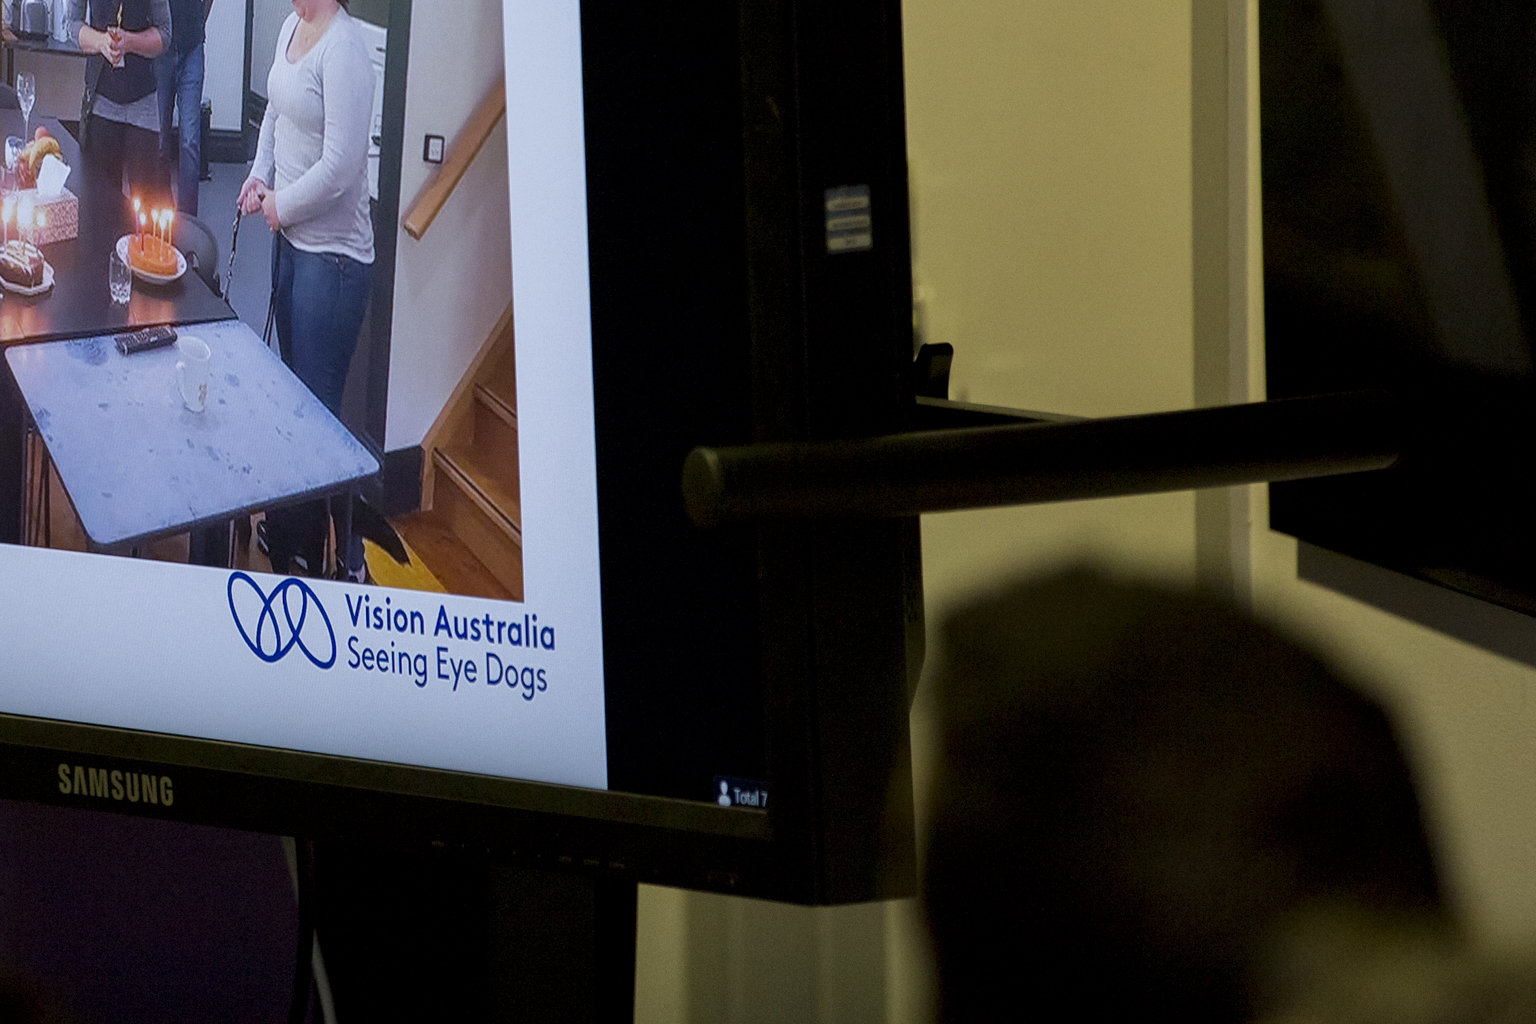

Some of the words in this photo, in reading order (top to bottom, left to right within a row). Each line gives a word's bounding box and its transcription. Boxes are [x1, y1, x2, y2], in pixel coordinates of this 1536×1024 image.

[345, 593, 424, 636] Vision
[433, 604, 555, 651] Australia
[348, 635, 427, 688] Seeing
[436, 646, 477, 692] Eye
[486, 652, 548, 701] Dogs
[58, 763, 174, 807] SAMSUNG
[733, 788, 760, 807] Total
